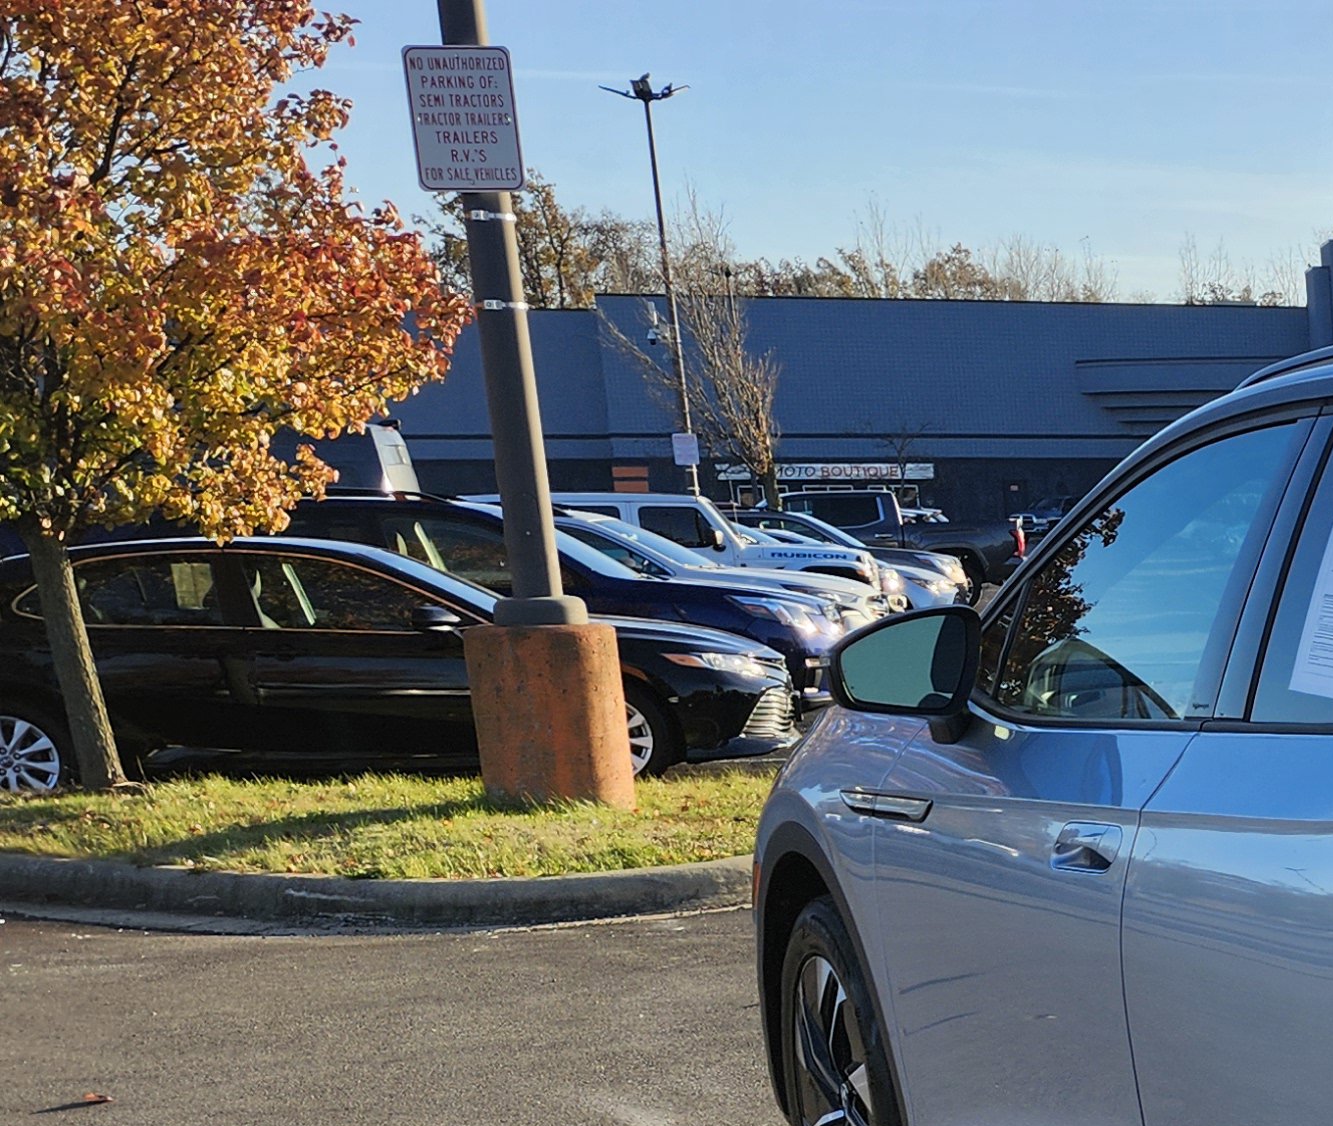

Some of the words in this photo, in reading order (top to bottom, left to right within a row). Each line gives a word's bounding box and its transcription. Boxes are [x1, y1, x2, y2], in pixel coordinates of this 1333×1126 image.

[408, 56, 424, 71] NO
[427, 56, 505, 71] UNAUTHORIZED
[420, 75, 475, 89] PARKING
[479, 76, 499, 89] OF:
[419, 94, 445, 108] SEMI
[450, 94, 504, 108] TRACTORS
[417, 112, 462, 126] TRACTOR
[465, 112, 511, 127] TRAILERS
[436, 131, 498, 144] TRAILERS
[425, 167, 444, 180] FOR
[447, 167, 470, 180] SALE
[474, 167, 518, 181] VEHICLES
[820, 465, 899, 478] BOUTIQUE
[770, 552, 848, 560] RUBICON
